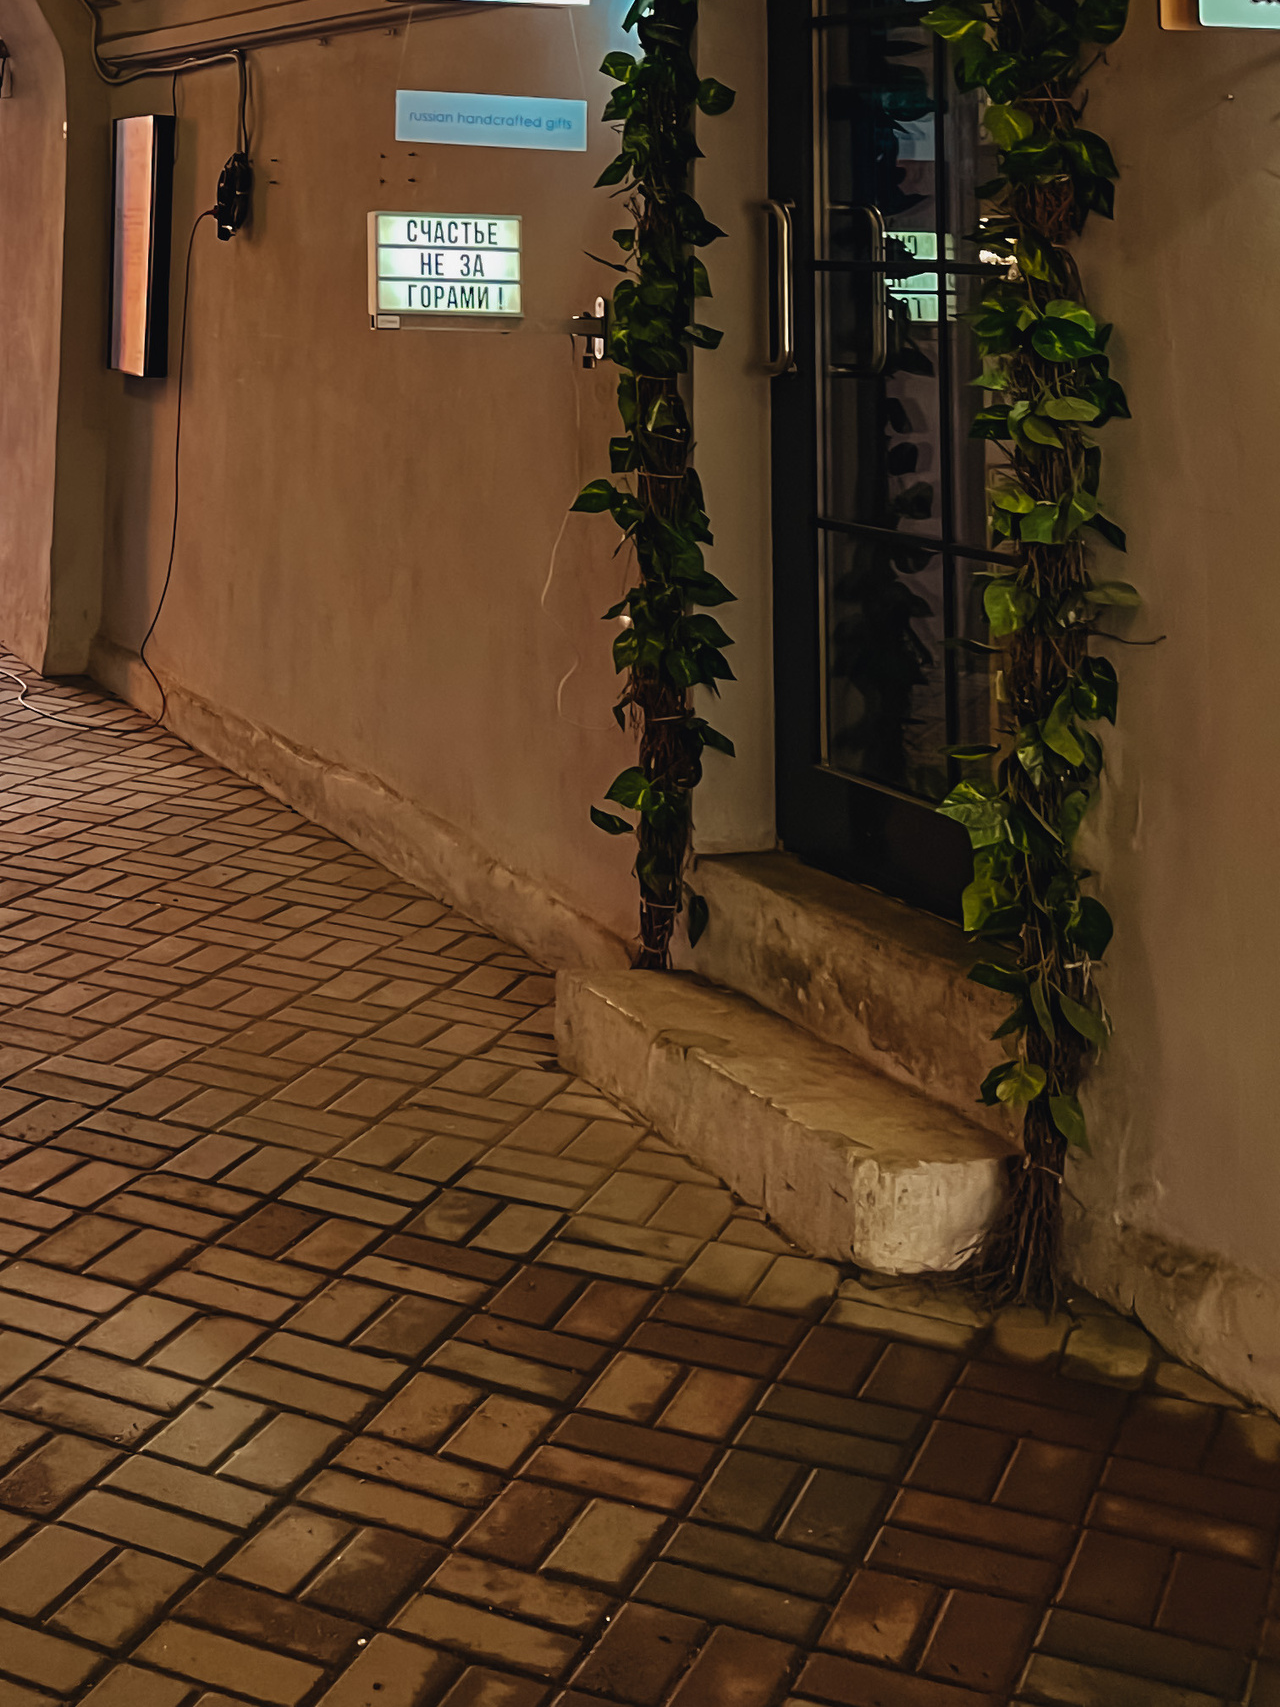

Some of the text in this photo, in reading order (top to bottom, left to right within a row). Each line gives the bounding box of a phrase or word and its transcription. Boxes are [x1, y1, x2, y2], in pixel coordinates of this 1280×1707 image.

[409, 111, 573, 131] russian handcrafted gifts
[406, 219, 498, 245] СЧАСТЬЕ
[420, 252, 485, 277] НЕ ЗА
[407, 284, 489, 310] ГОРАМИ
